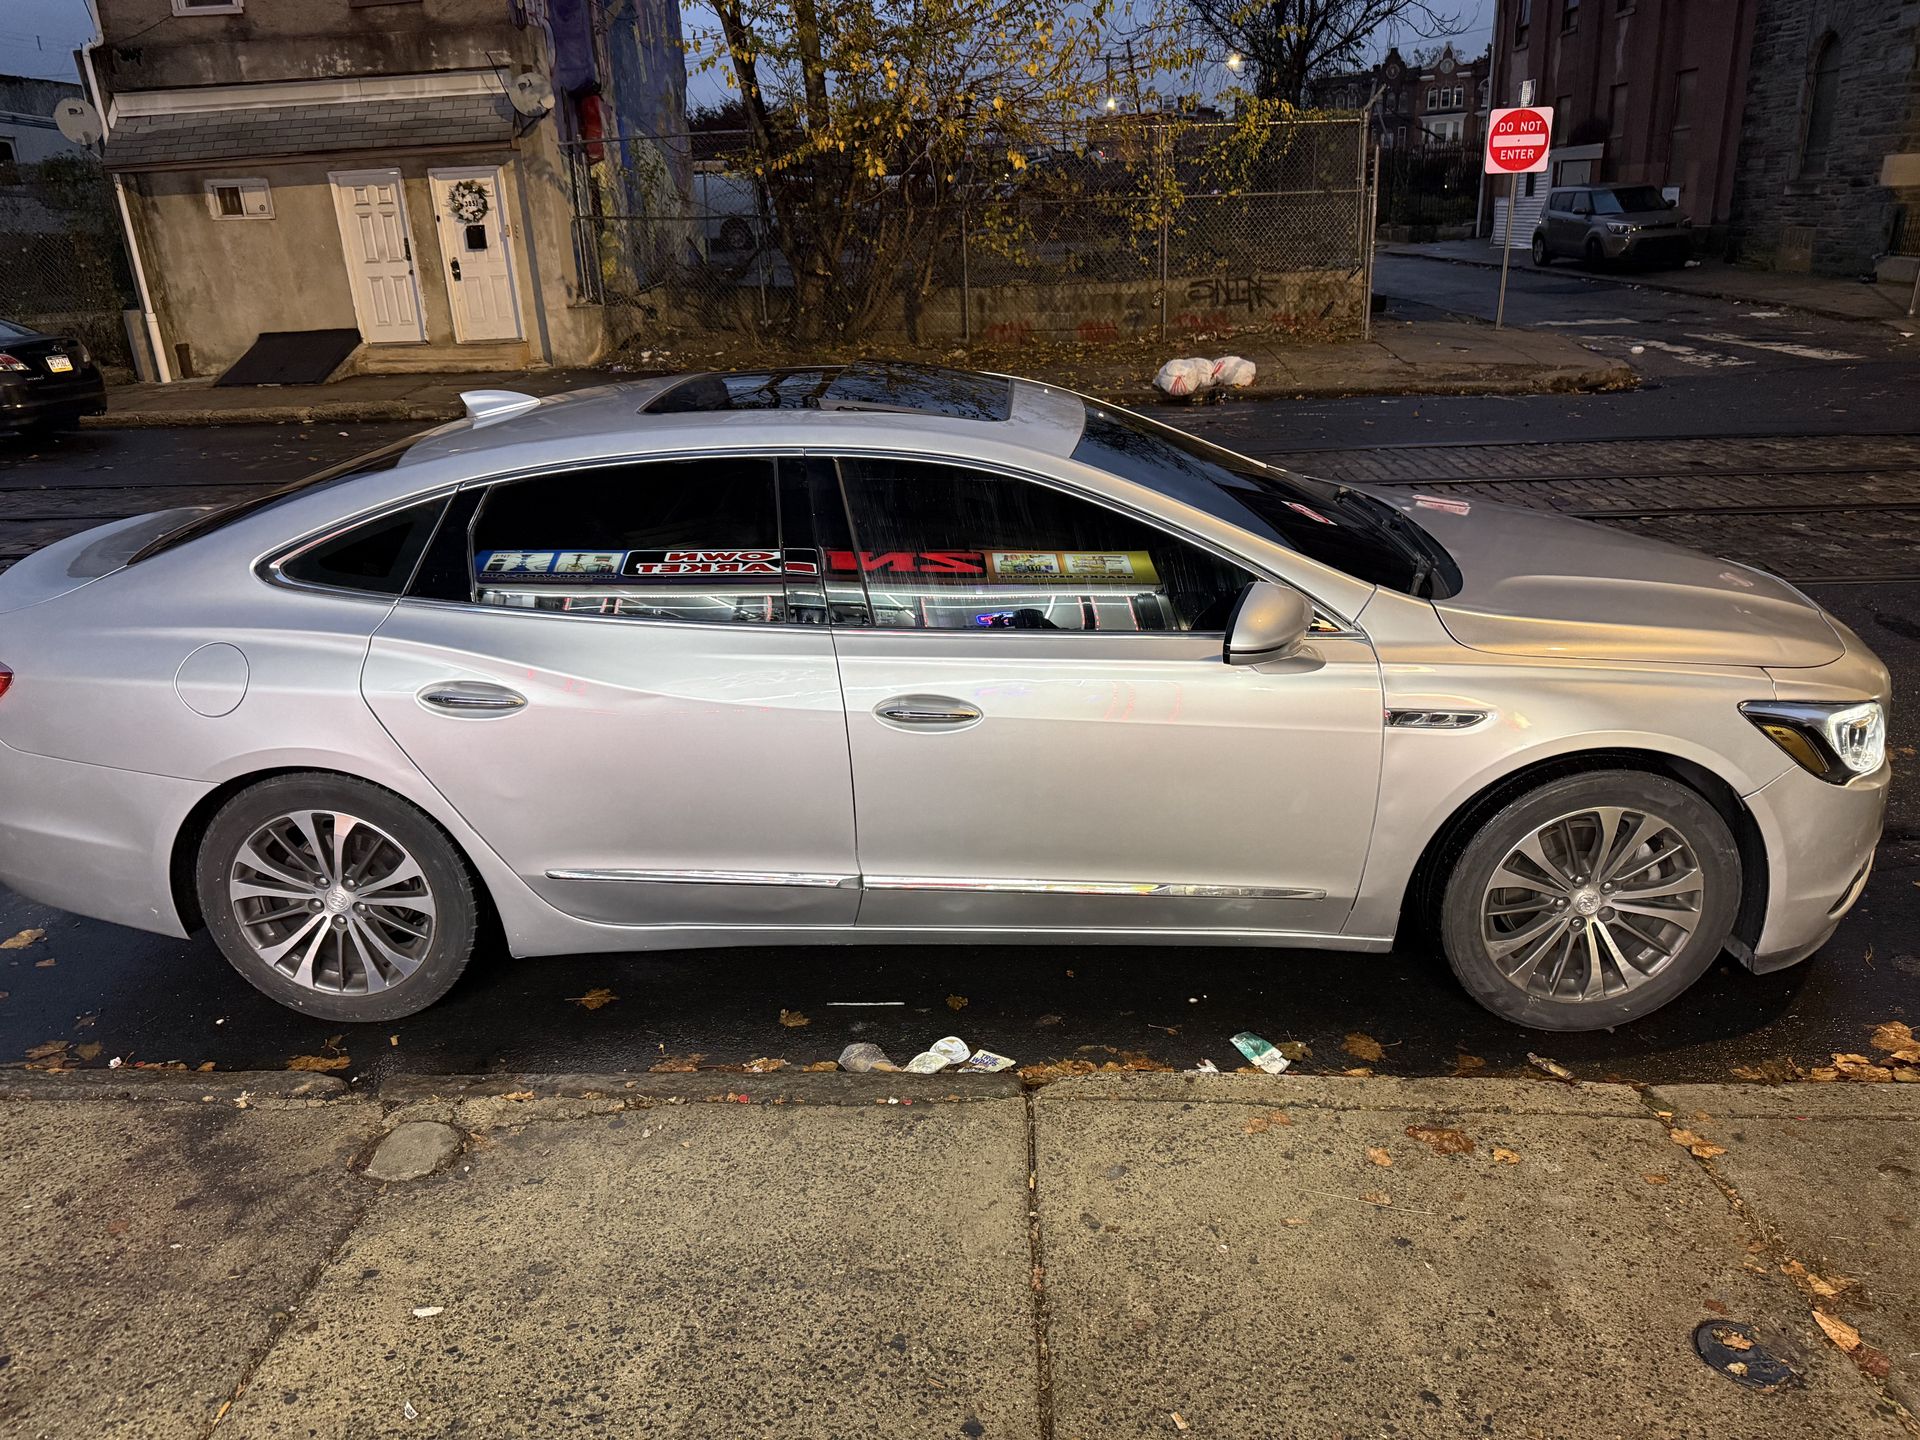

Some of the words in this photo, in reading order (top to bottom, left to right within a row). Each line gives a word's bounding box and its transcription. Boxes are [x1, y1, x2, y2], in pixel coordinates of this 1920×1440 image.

[1499, 122, 1514, 132] DO
[1520, 121, 1542, 131] NOT
[1500, 149, 1534, 160] ENTER
